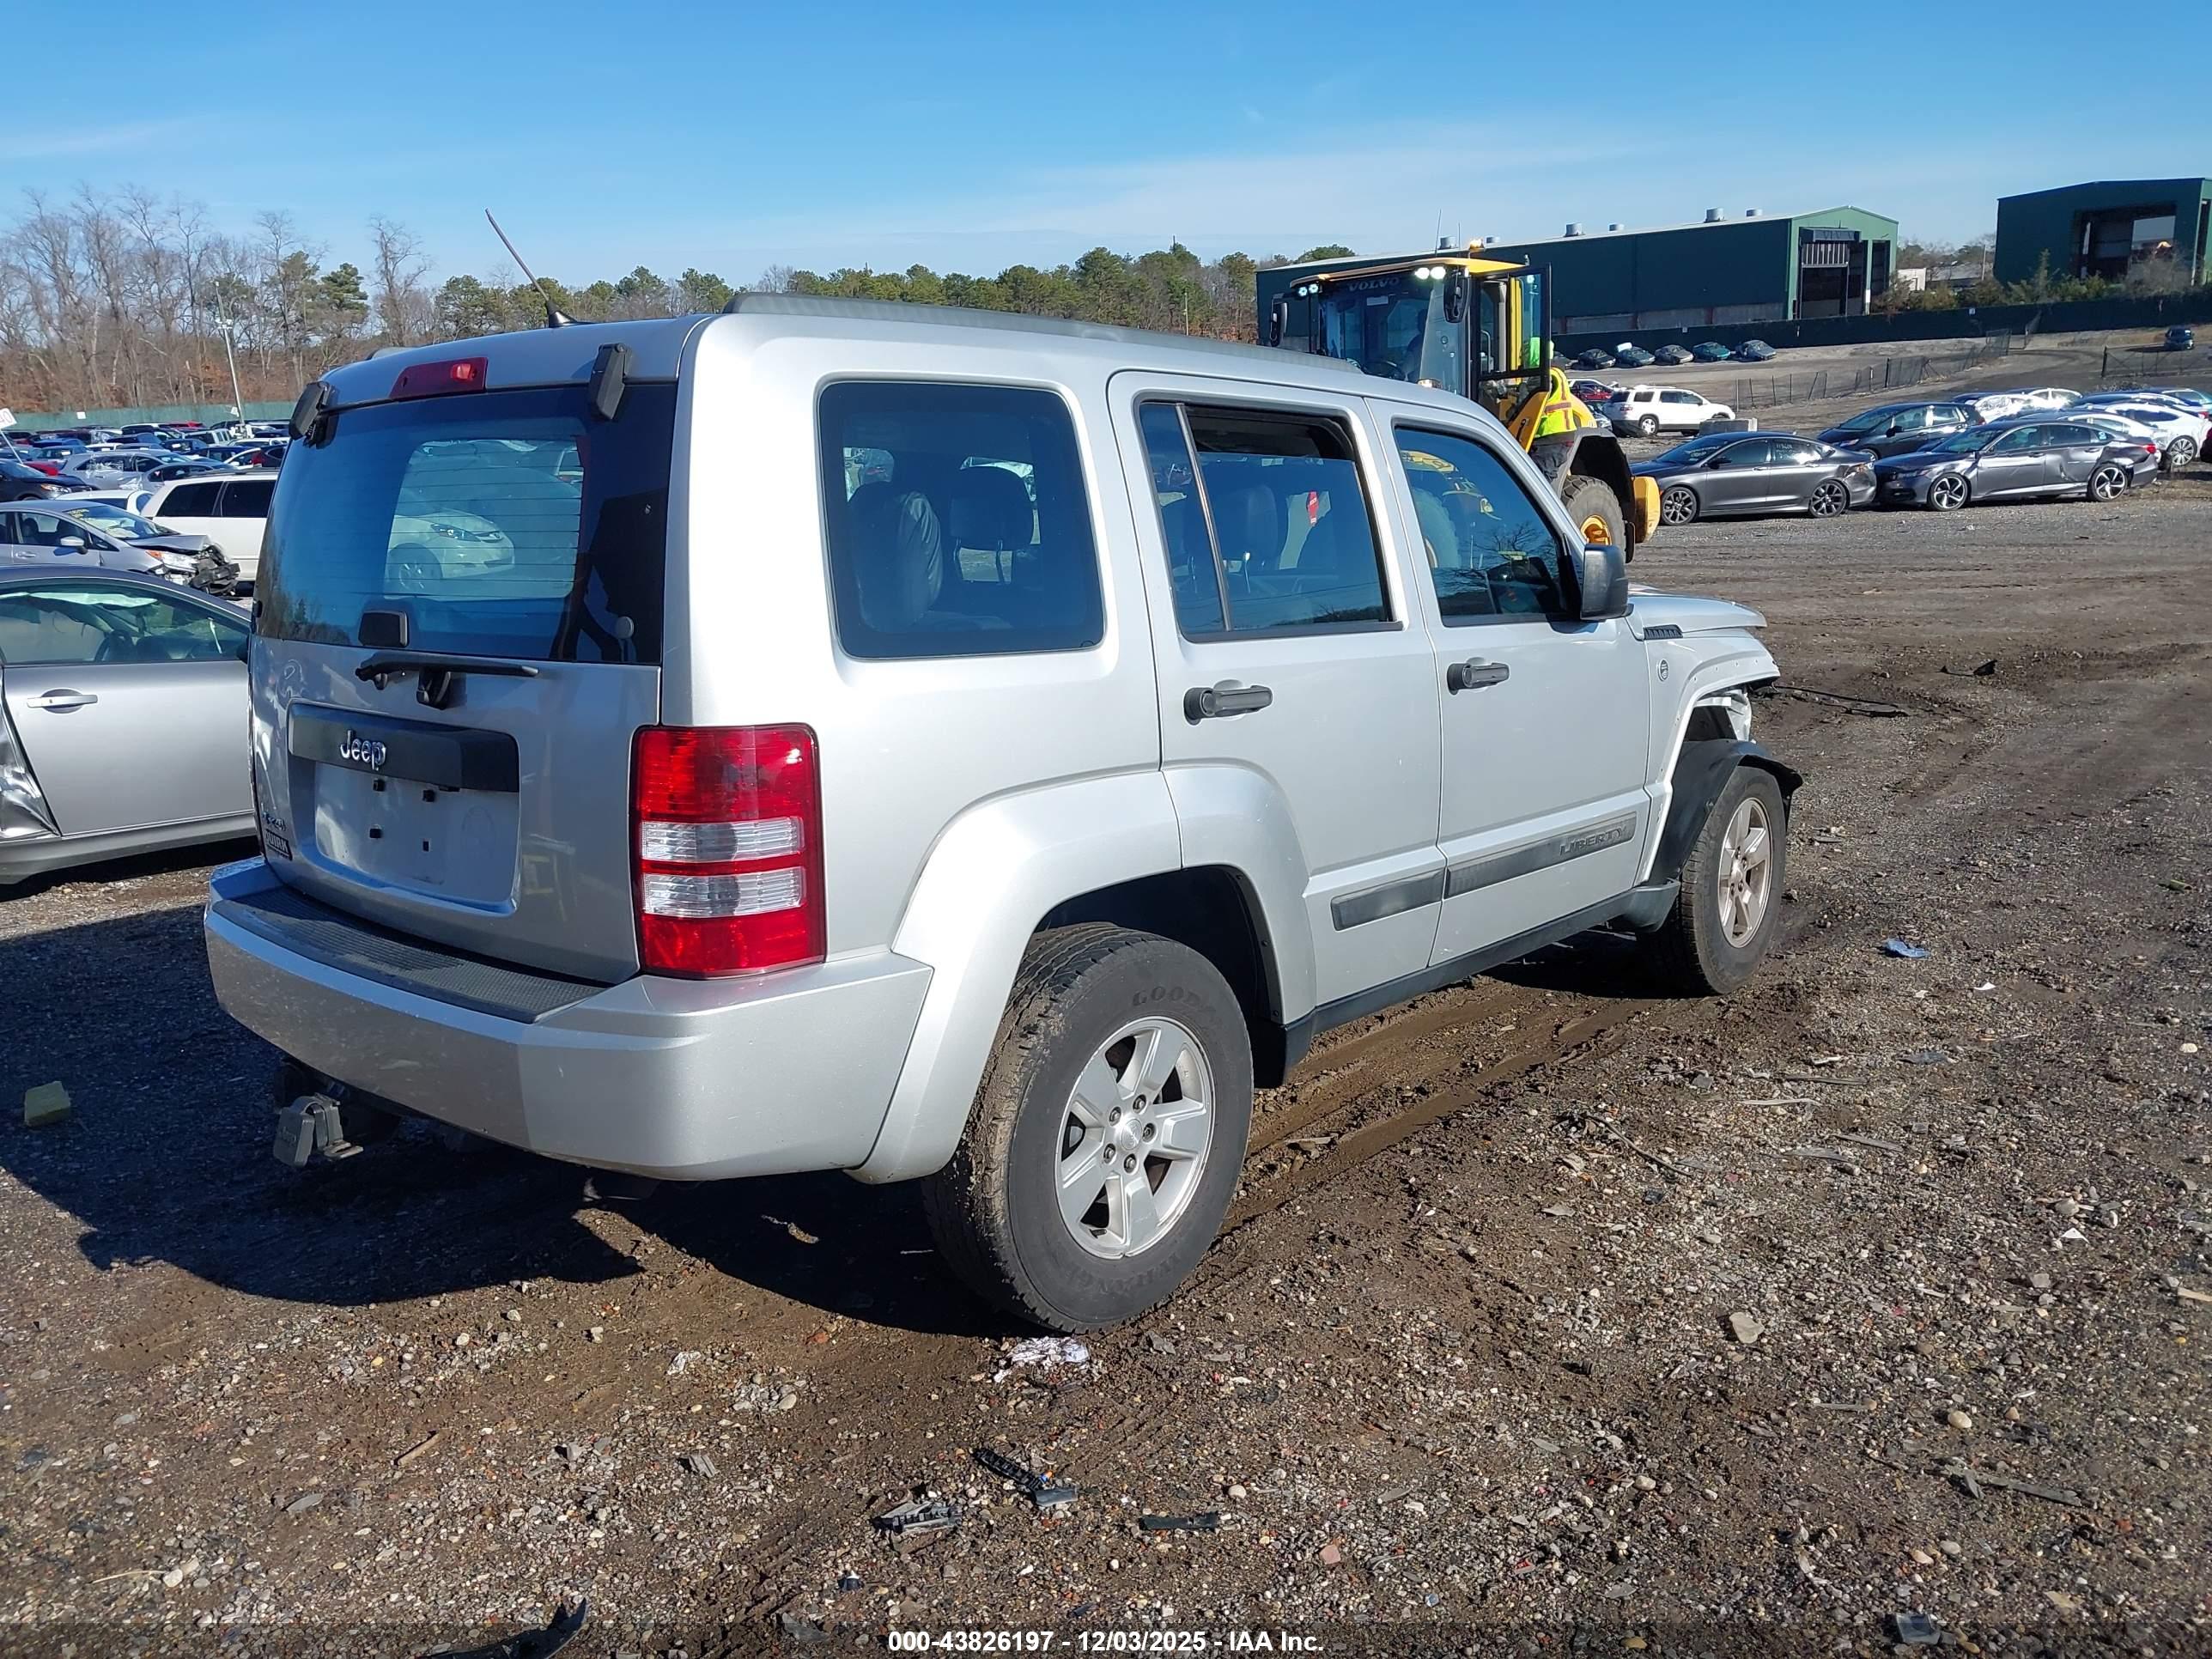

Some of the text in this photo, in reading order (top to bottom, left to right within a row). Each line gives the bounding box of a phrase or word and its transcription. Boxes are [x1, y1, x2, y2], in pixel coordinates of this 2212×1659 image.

[1346, 277, 1400, 292] VOLVO
[340, 729, 387, 770] Jeep
[1559, 823, 1627, 857] LIBERTY
